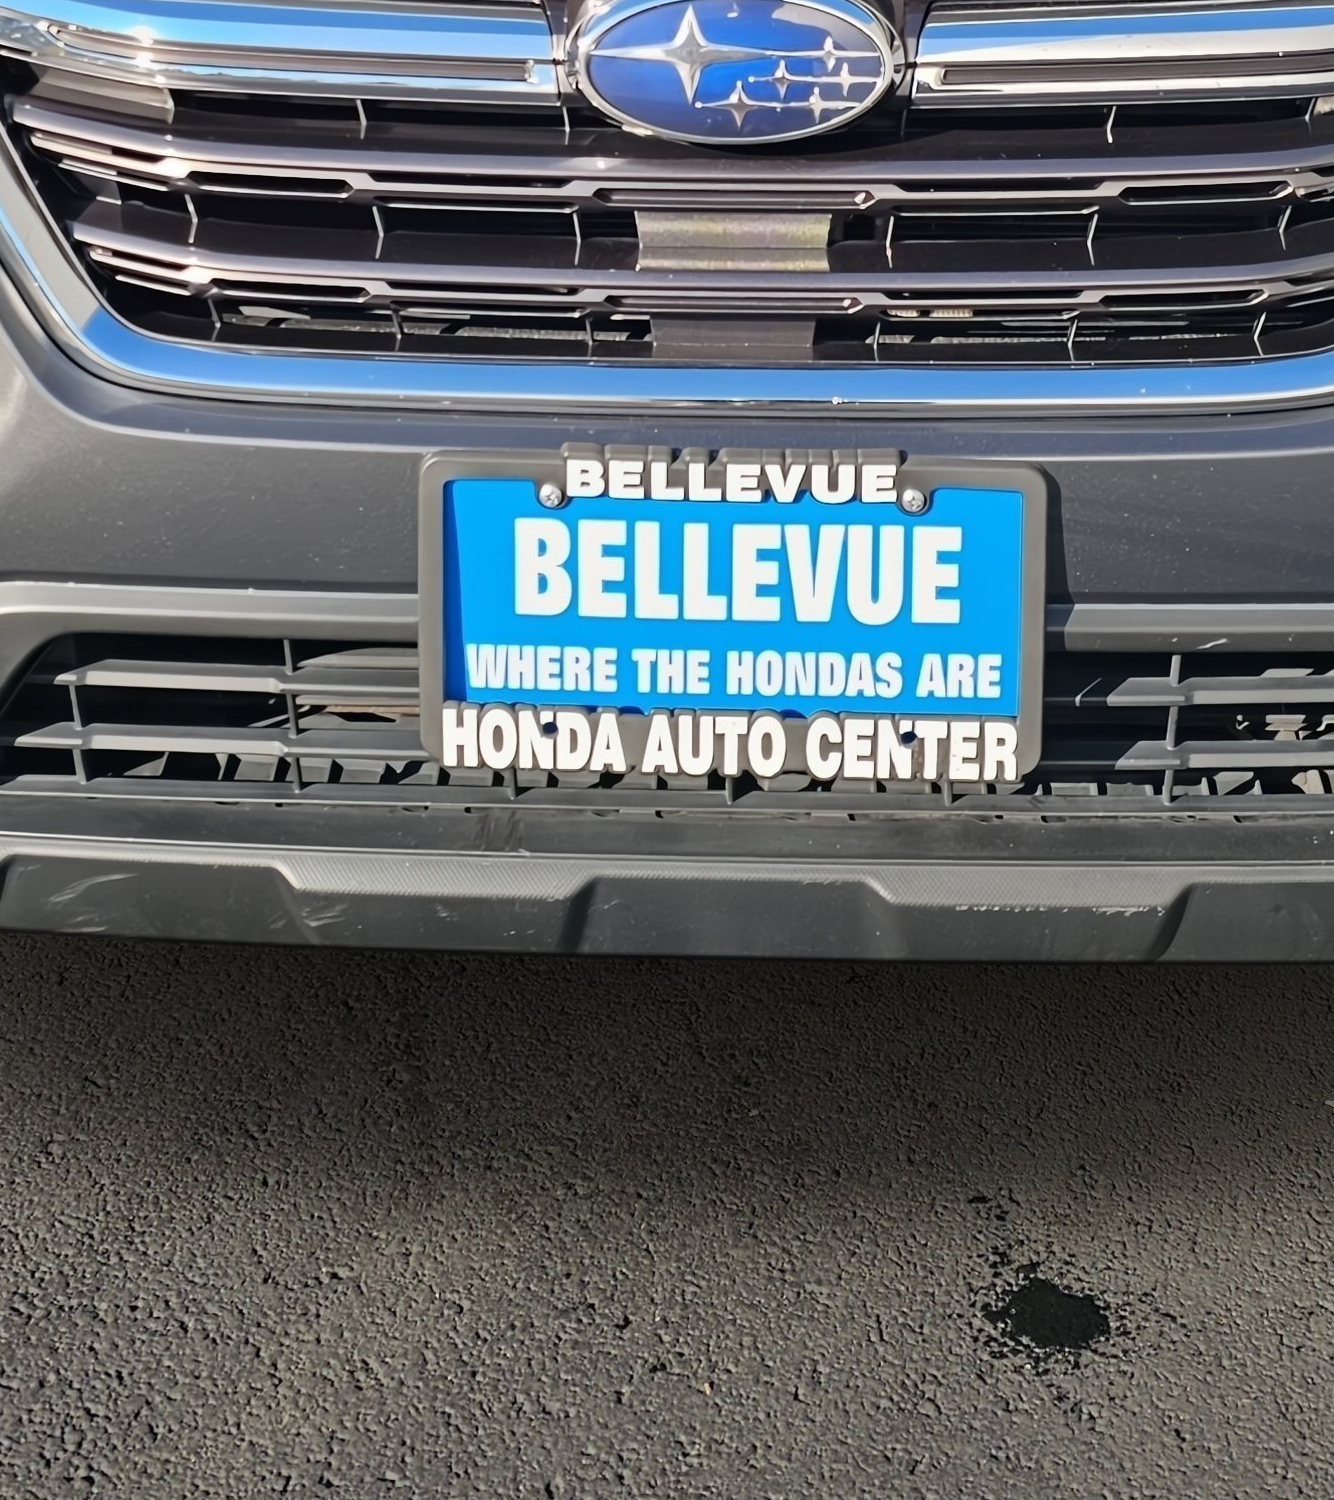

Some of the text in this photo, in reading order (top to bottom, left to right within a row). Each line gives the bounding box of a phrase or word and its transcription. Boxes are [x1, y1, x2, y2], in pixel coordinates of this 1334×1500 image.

[565, 459, 898, 504] BELLEVUE
[513, 516, 963, 626] BELLEVUE
[466, 643, 1003, 699] WHERE THE HONDAS ARE
[442, 708, 1018, 782] HONDA AUTO CENTER
